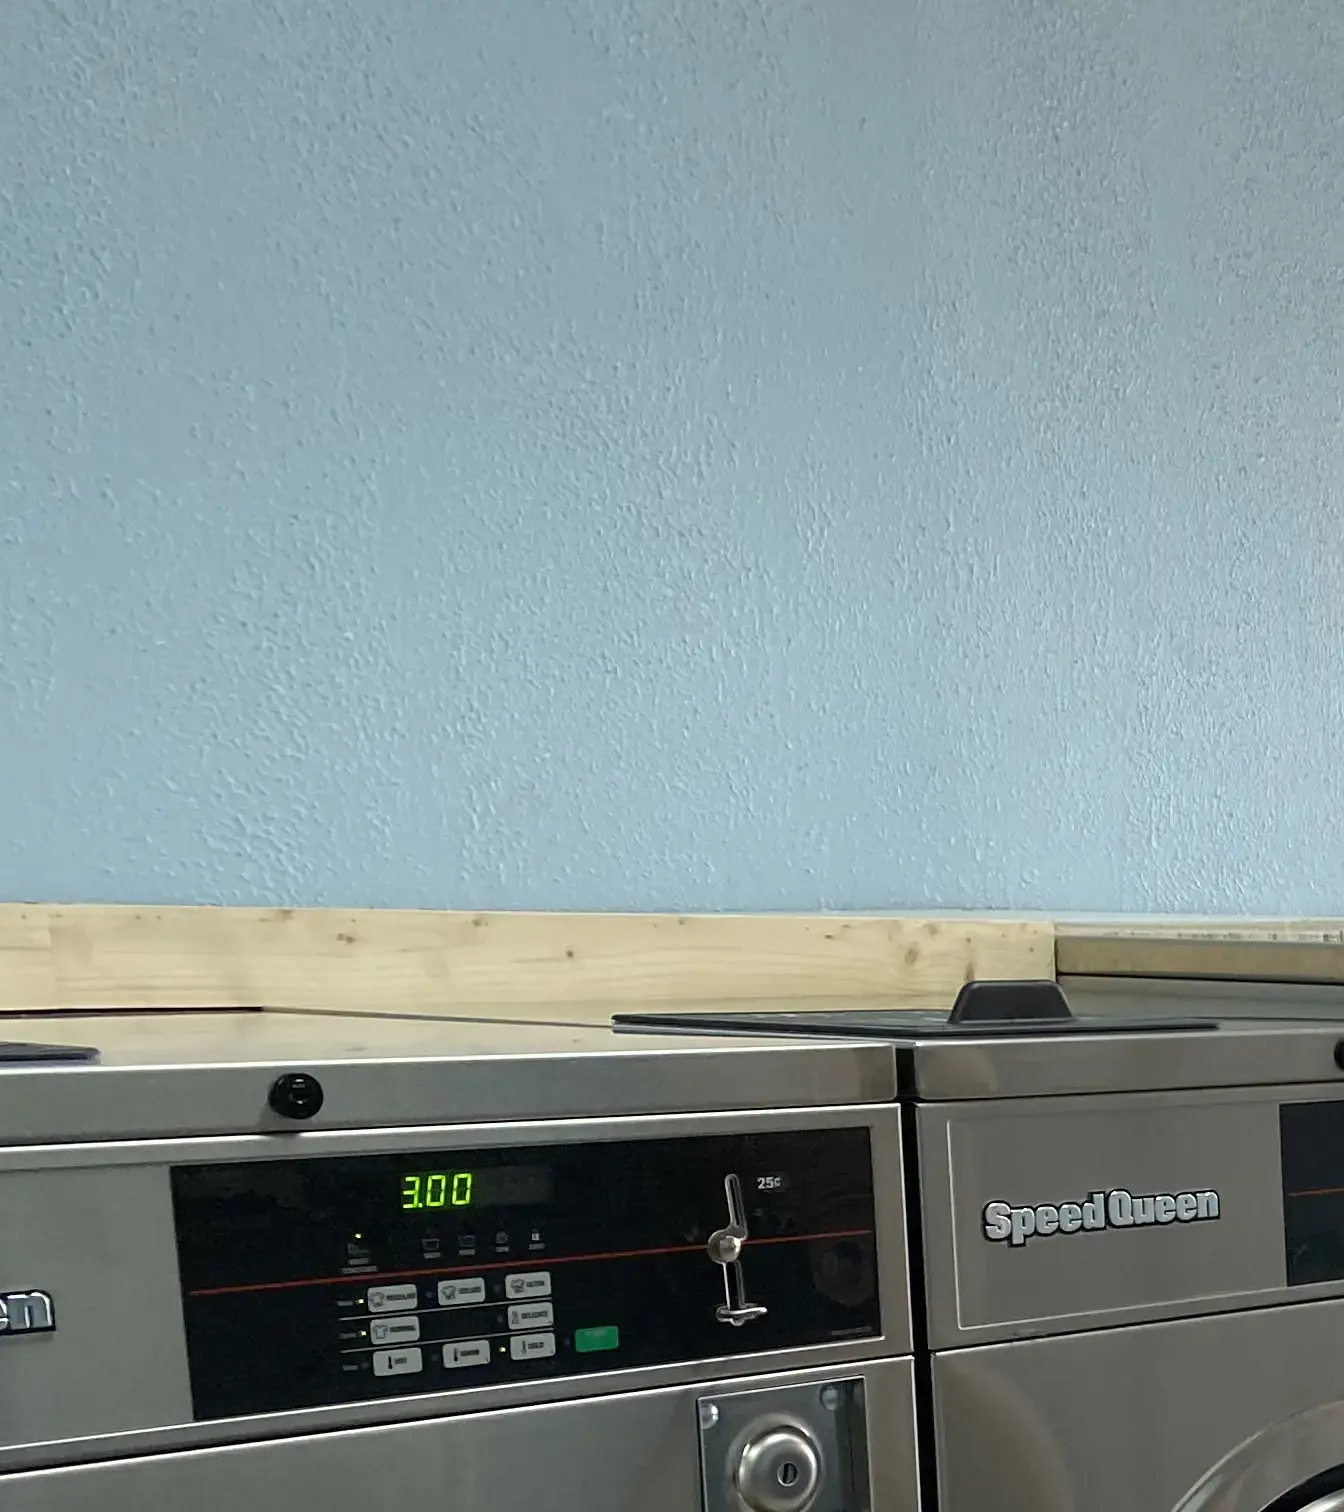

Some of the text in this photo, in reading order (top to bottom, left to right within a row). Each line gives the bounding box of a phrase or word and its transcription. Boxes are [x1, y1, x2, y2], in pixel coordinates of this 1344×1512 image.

[402, 1172, 472, 1209] 3.00
[756, 1176, 781, 1190] 25¢
[983, 1188, 1220, 1247] Speed Queen
